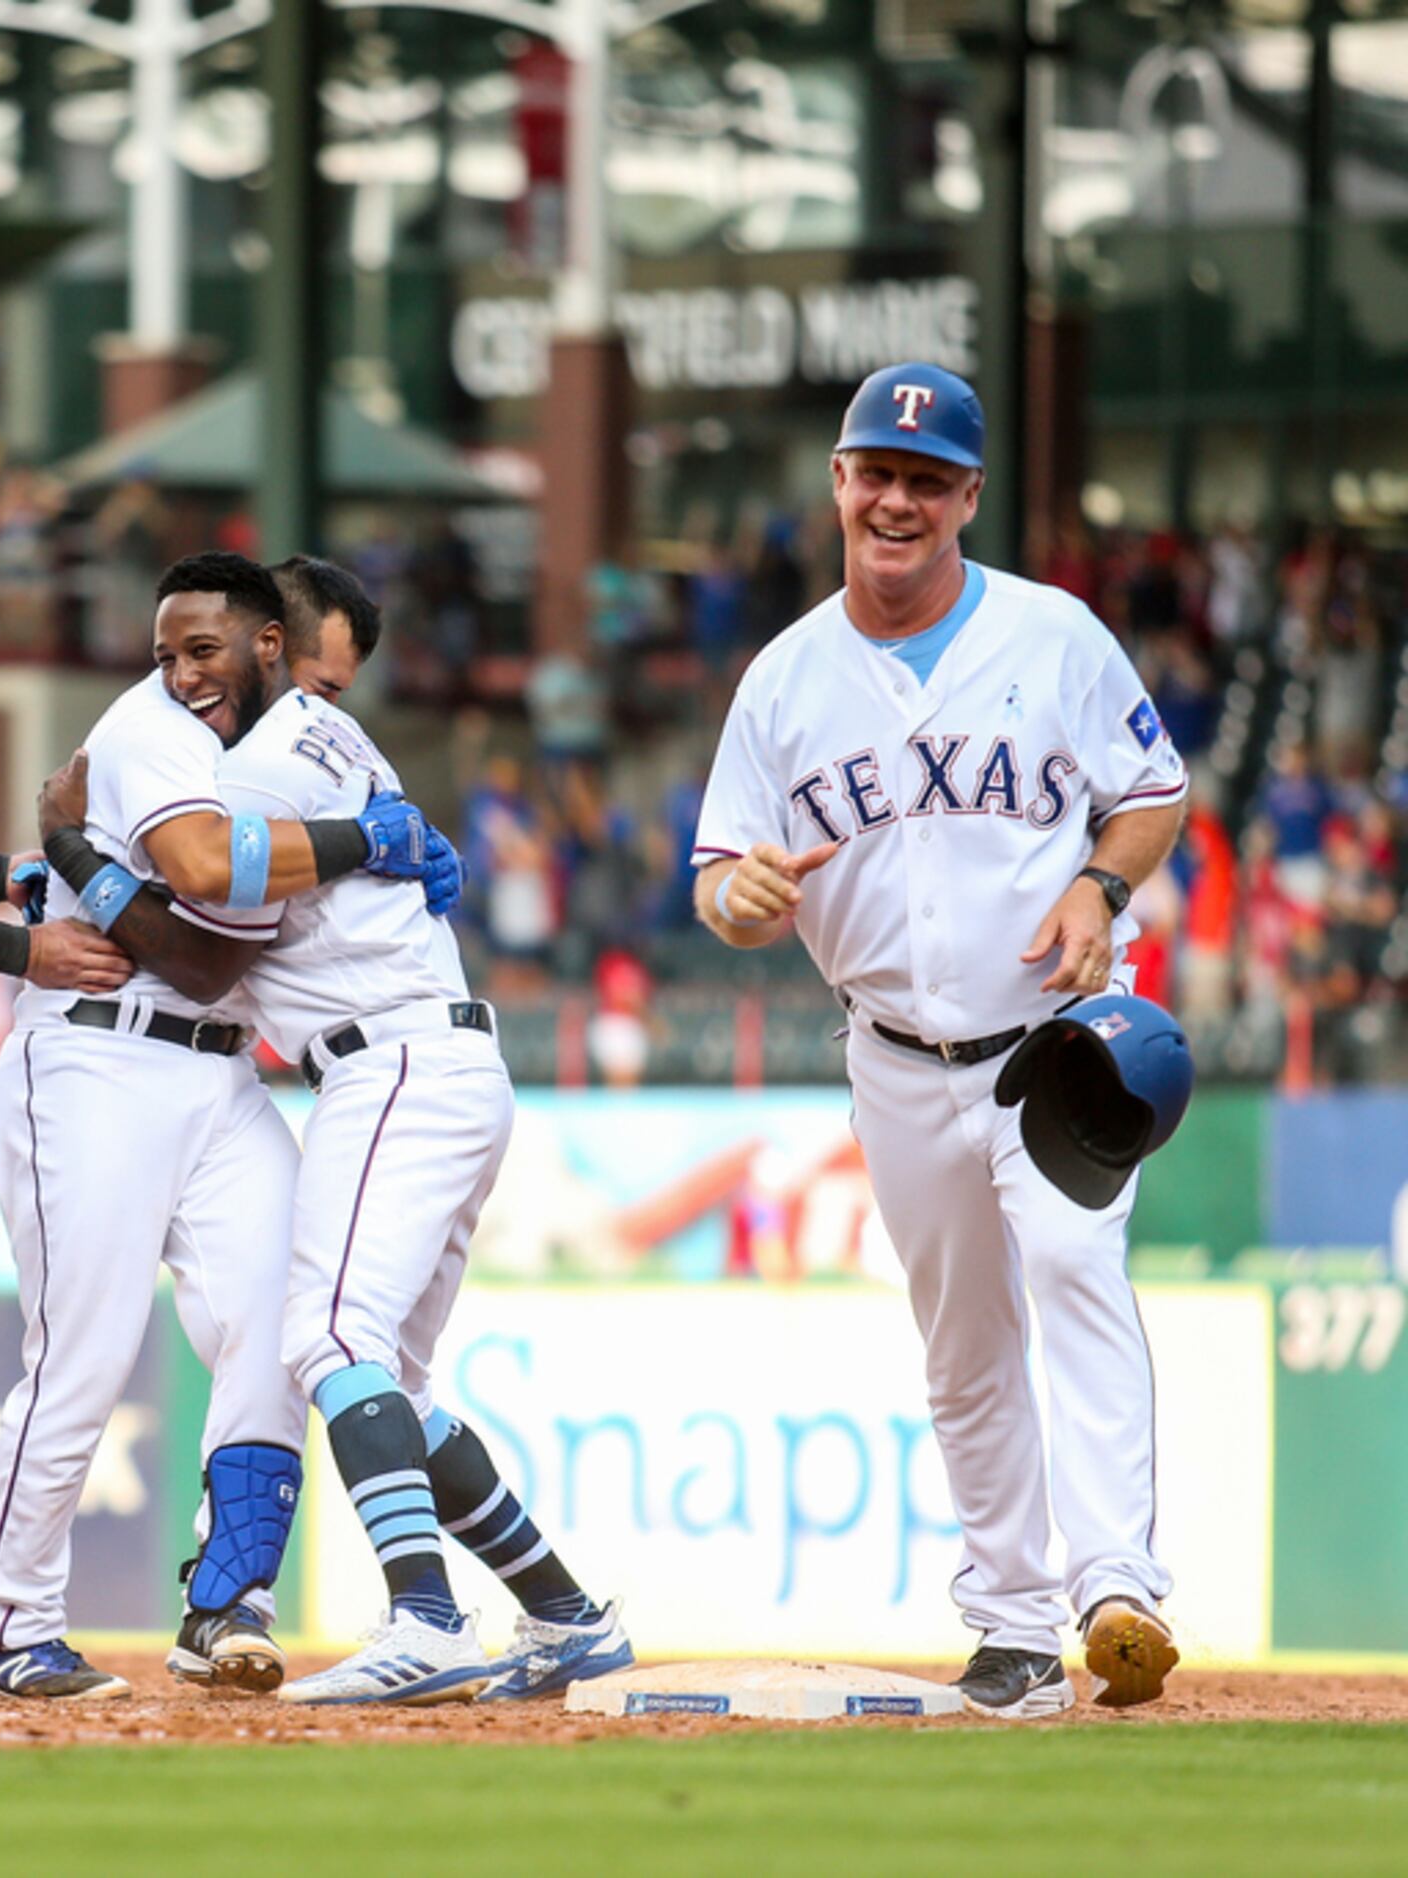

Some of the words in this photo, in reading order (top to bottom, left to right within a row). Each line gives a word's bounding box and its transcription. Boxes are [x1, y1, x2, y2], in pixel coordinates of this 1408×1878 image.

[892, 383, 933, 432] T
[788, 734, 1079, 847] TEXAS
[1278, 1283, 1405, 1372] 377
